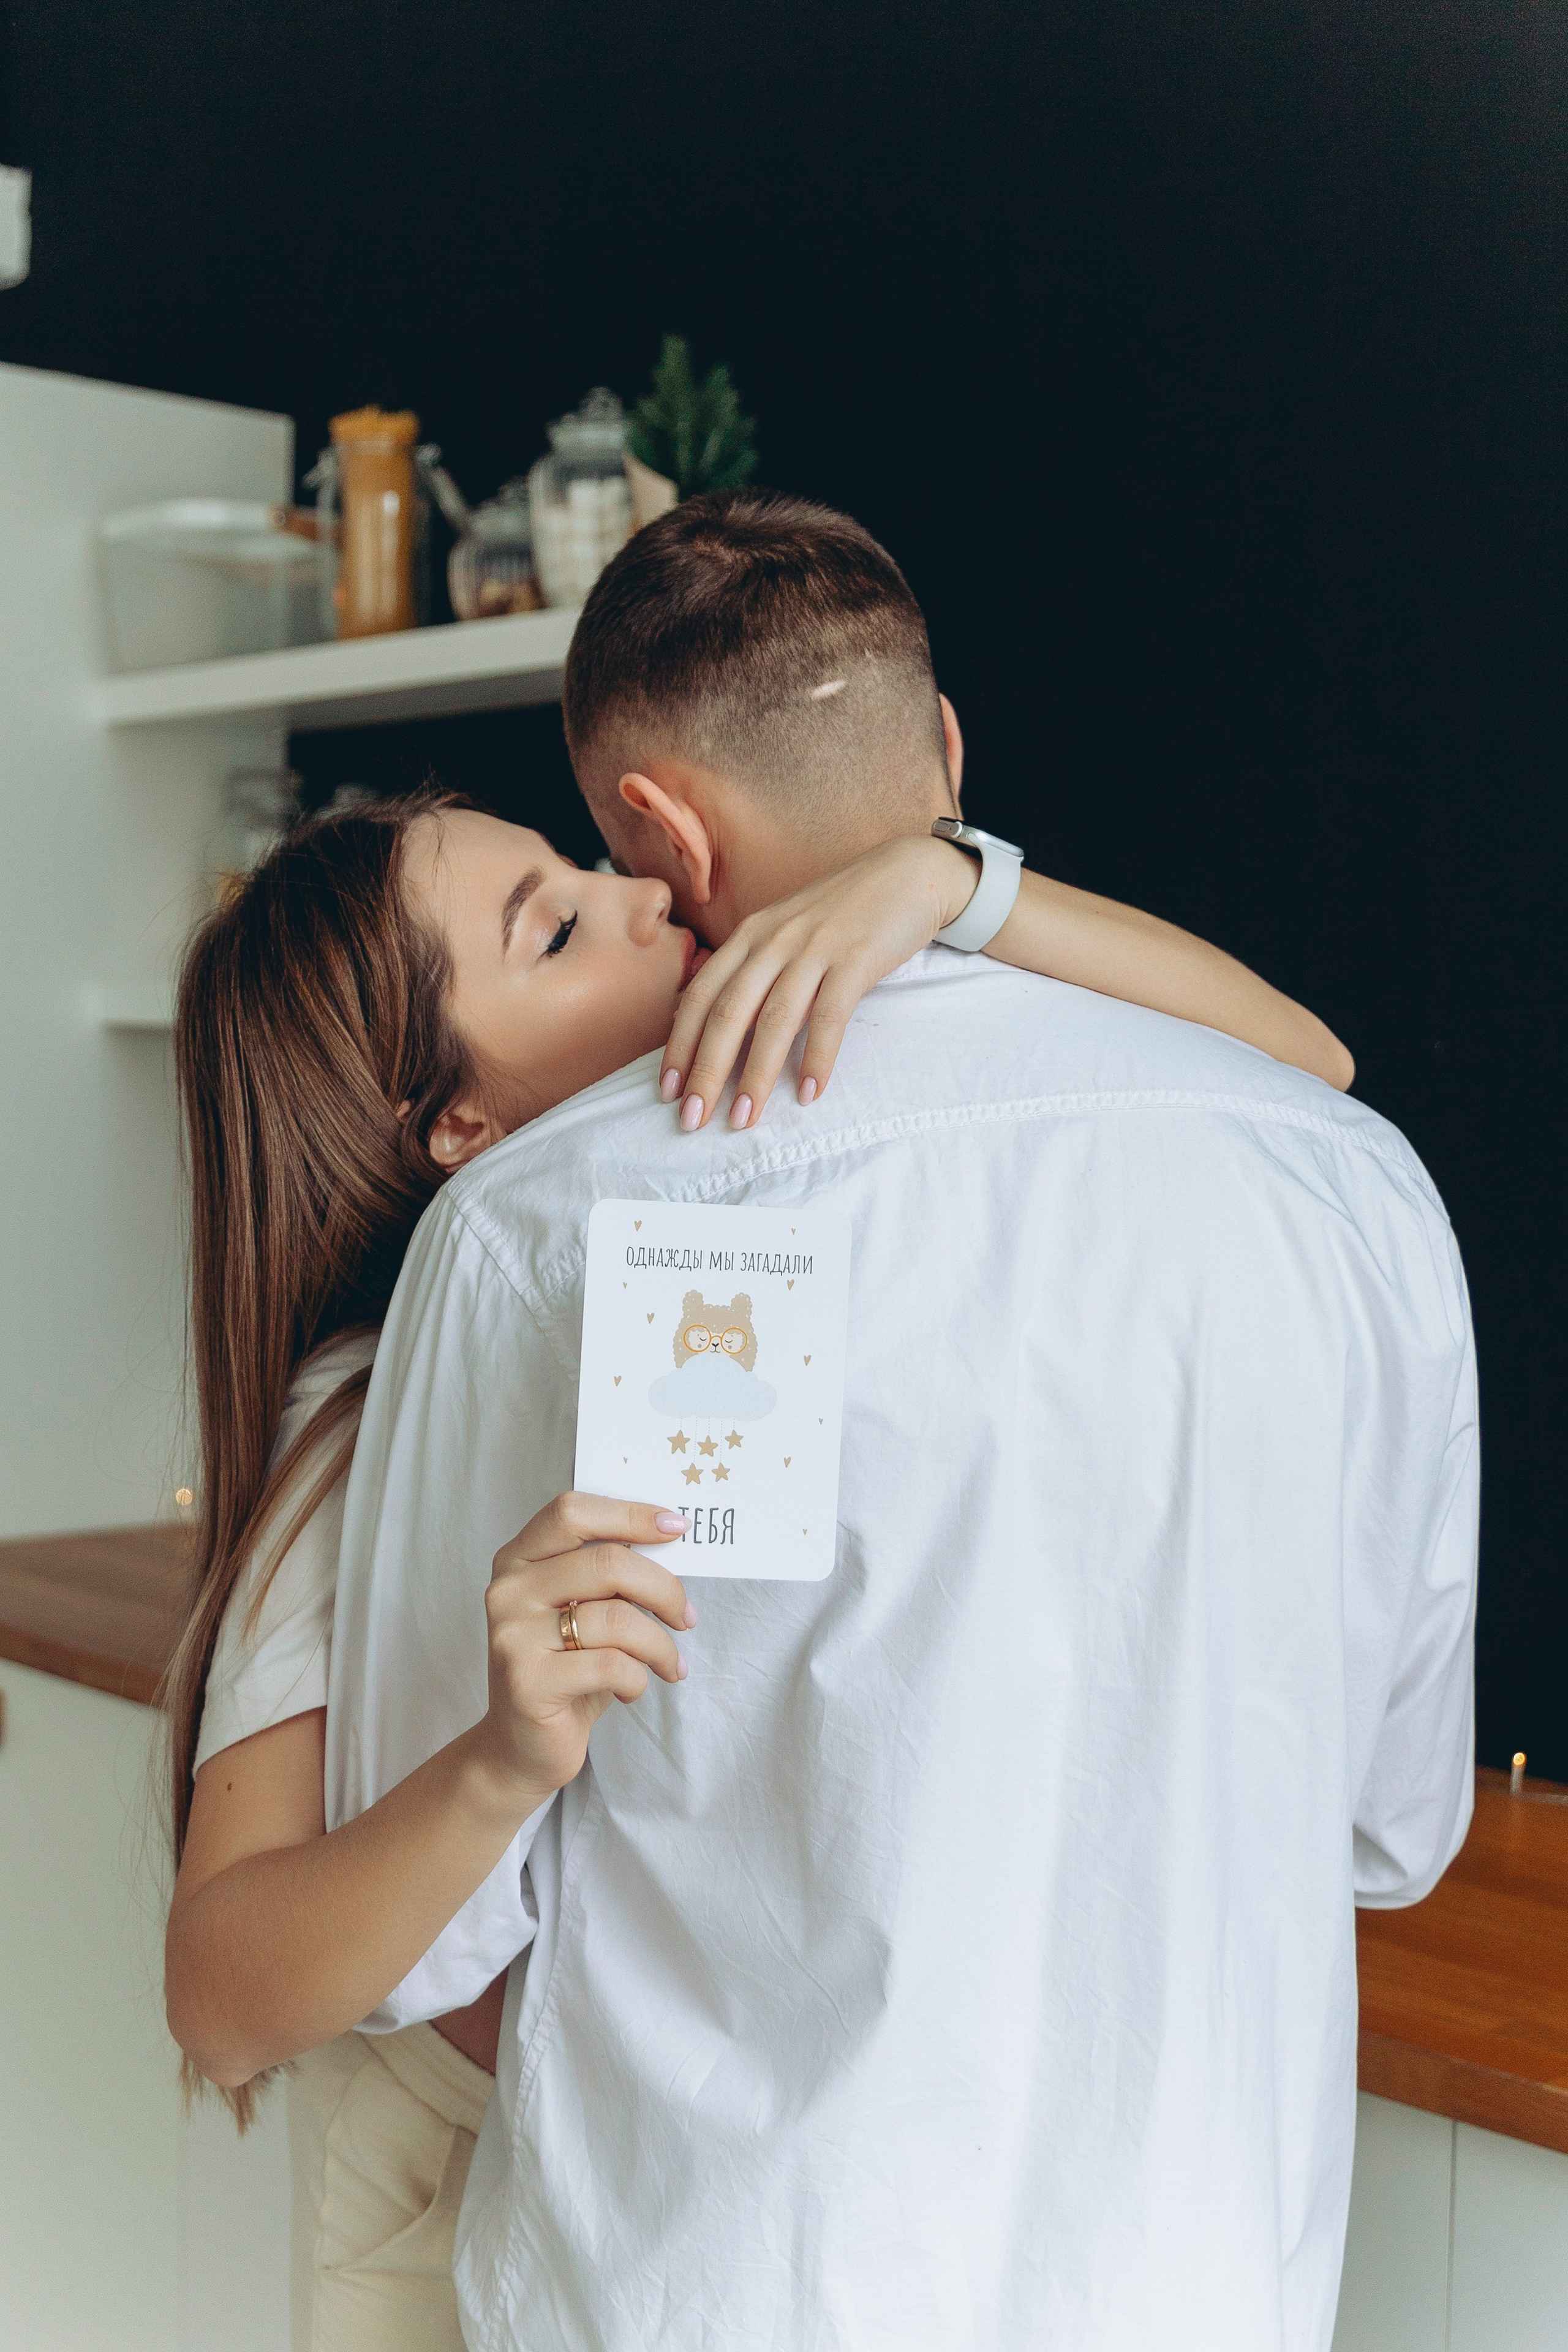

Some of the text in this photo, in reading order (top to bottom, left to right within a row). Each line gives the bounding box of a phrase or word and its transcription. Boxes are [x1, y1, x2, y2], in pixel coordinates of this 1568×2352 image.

[626, 1246, 813, 1276] ОДНАЖДЫ МЫ ЗАГАДАЛИ
[677, 1506, 735, 1545] ТЕБЯ
